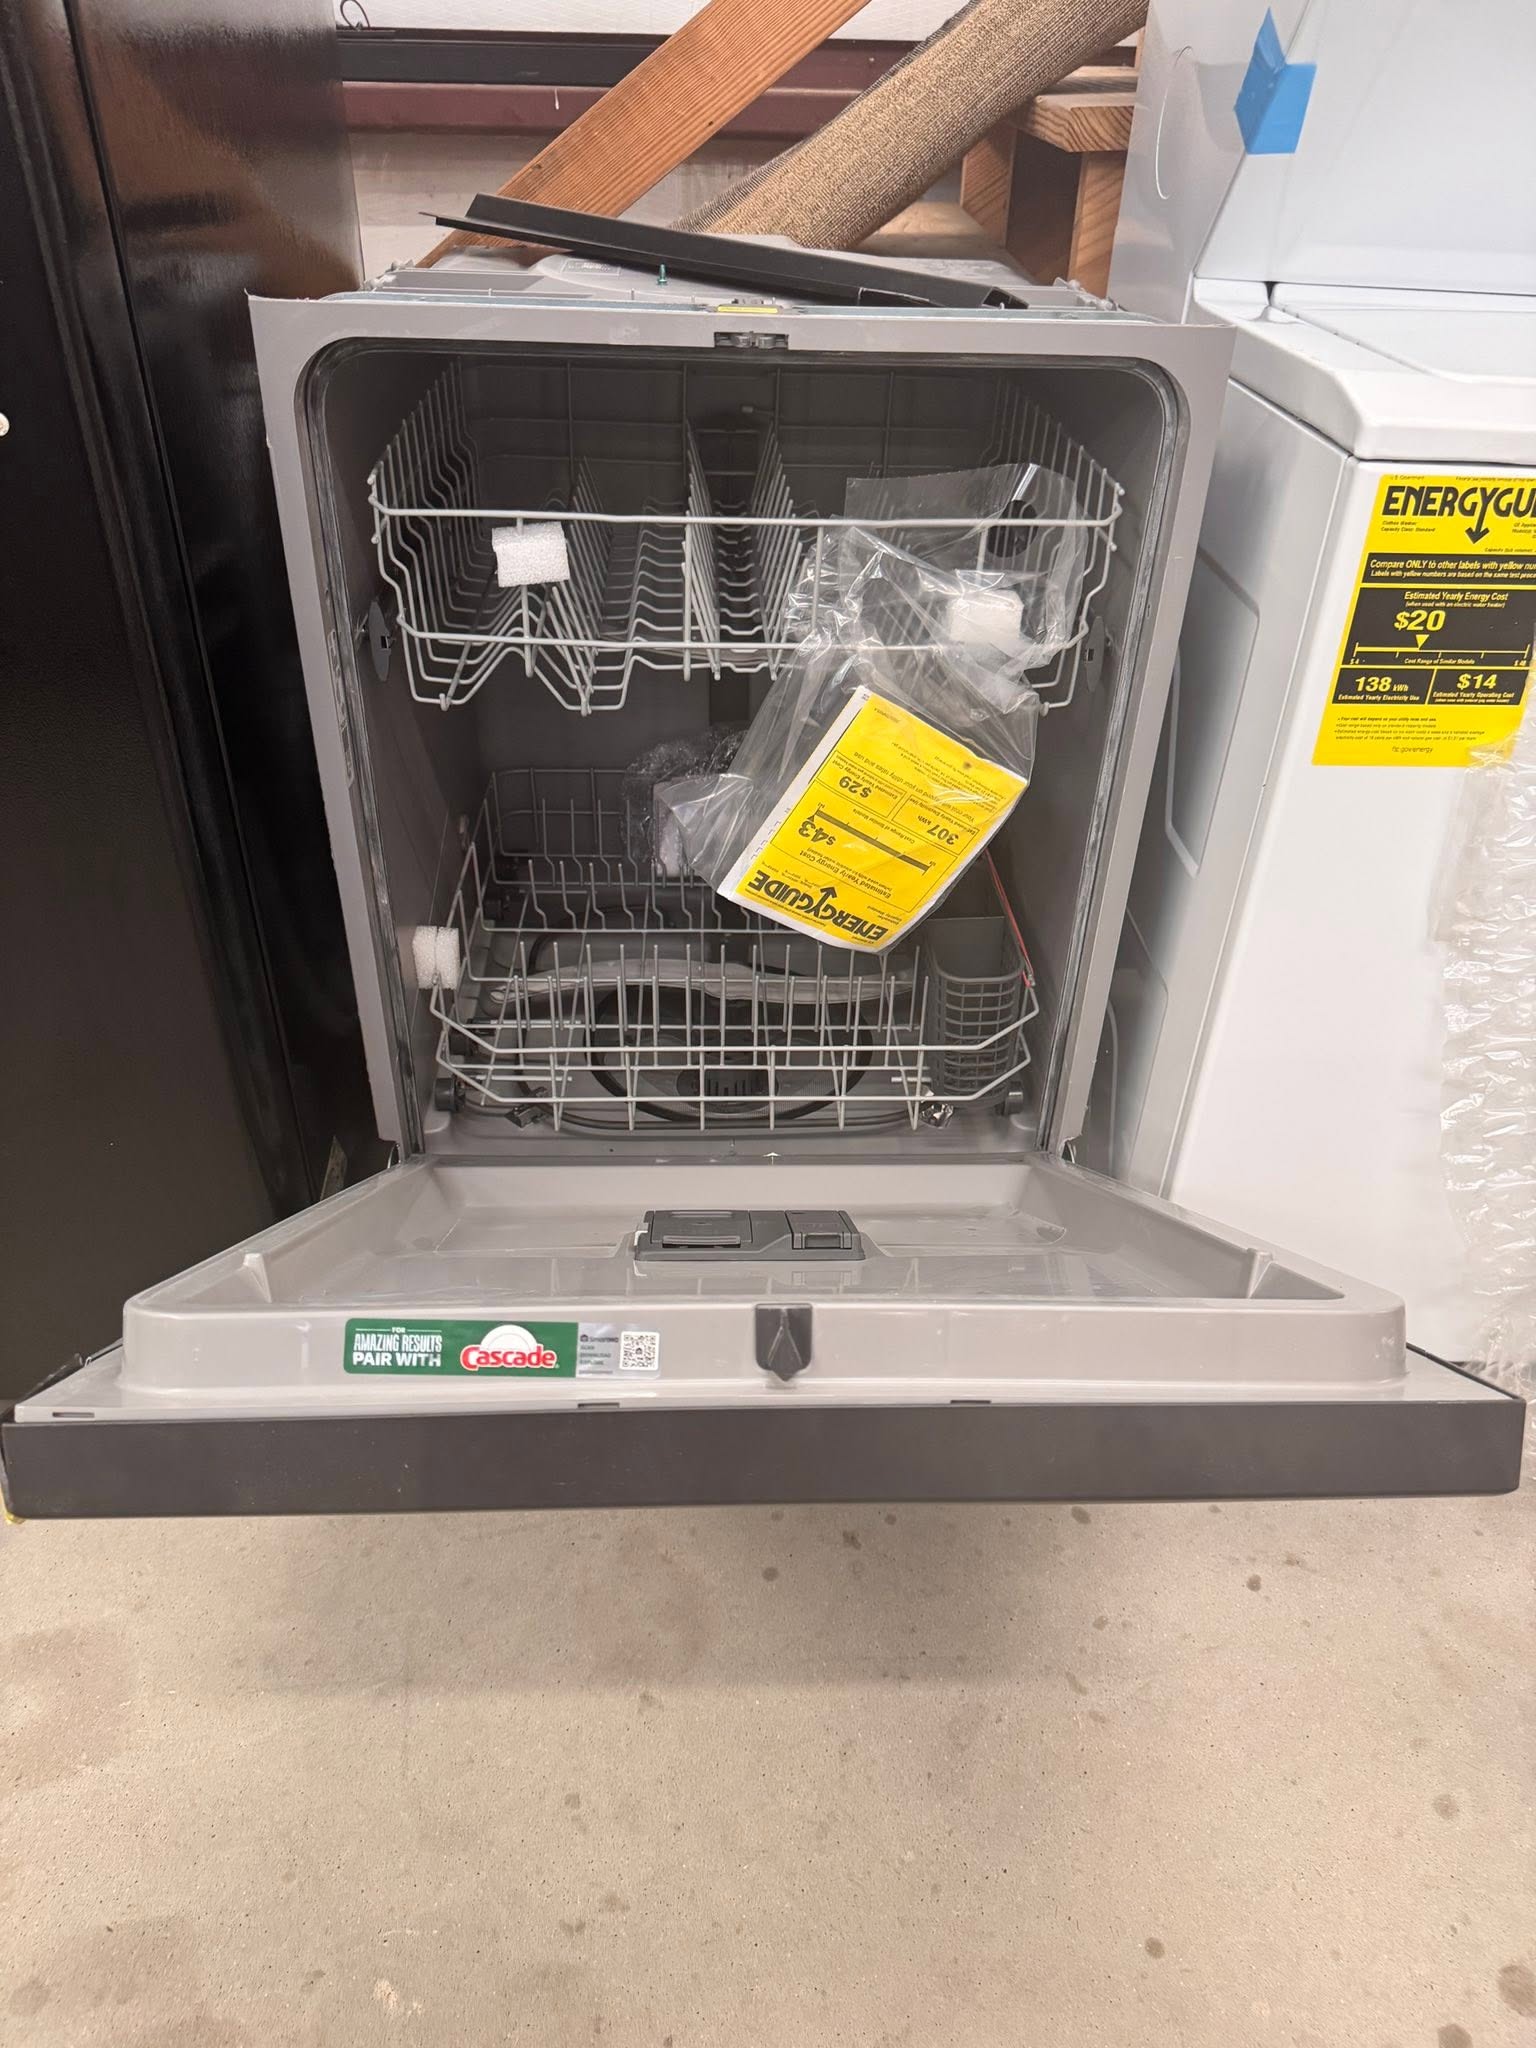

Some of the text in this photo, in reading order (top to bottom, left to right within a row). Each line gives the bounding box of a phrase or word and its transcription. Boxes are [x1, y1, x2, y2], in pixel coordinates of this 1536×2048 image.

[1370, 559, 1536, 572] Compare ONLY to other labels with yellow nu
[1402, 570, 1422, 578] yellow
[1404, 592, 1508, 602] Estimated Yearly Energy Cost
[1394, 610, 1446, 631] $20
[1355, 676, 1409, 692] 138 kWh
[1456, 673, 1498, 690] $14
[837, 774, 873, 799] $29
[796, 819, 836, 846] $43
[926, 822, 959, 845] 307
[798, 850, 815, 861] Cost
[815, 857, 839, 873] Energy
[838, 870, 860, 883] Yearly
[859, 880, 891, 898] Estimated
[747, 869, 888, 940] ENERGYGUIDE
[353, 1333, 442, 1353] AMAZING RESULTS
[352, 1352, 442, 1367] PAIR WITH
[461, 1344, 556, 1370] Cascade
